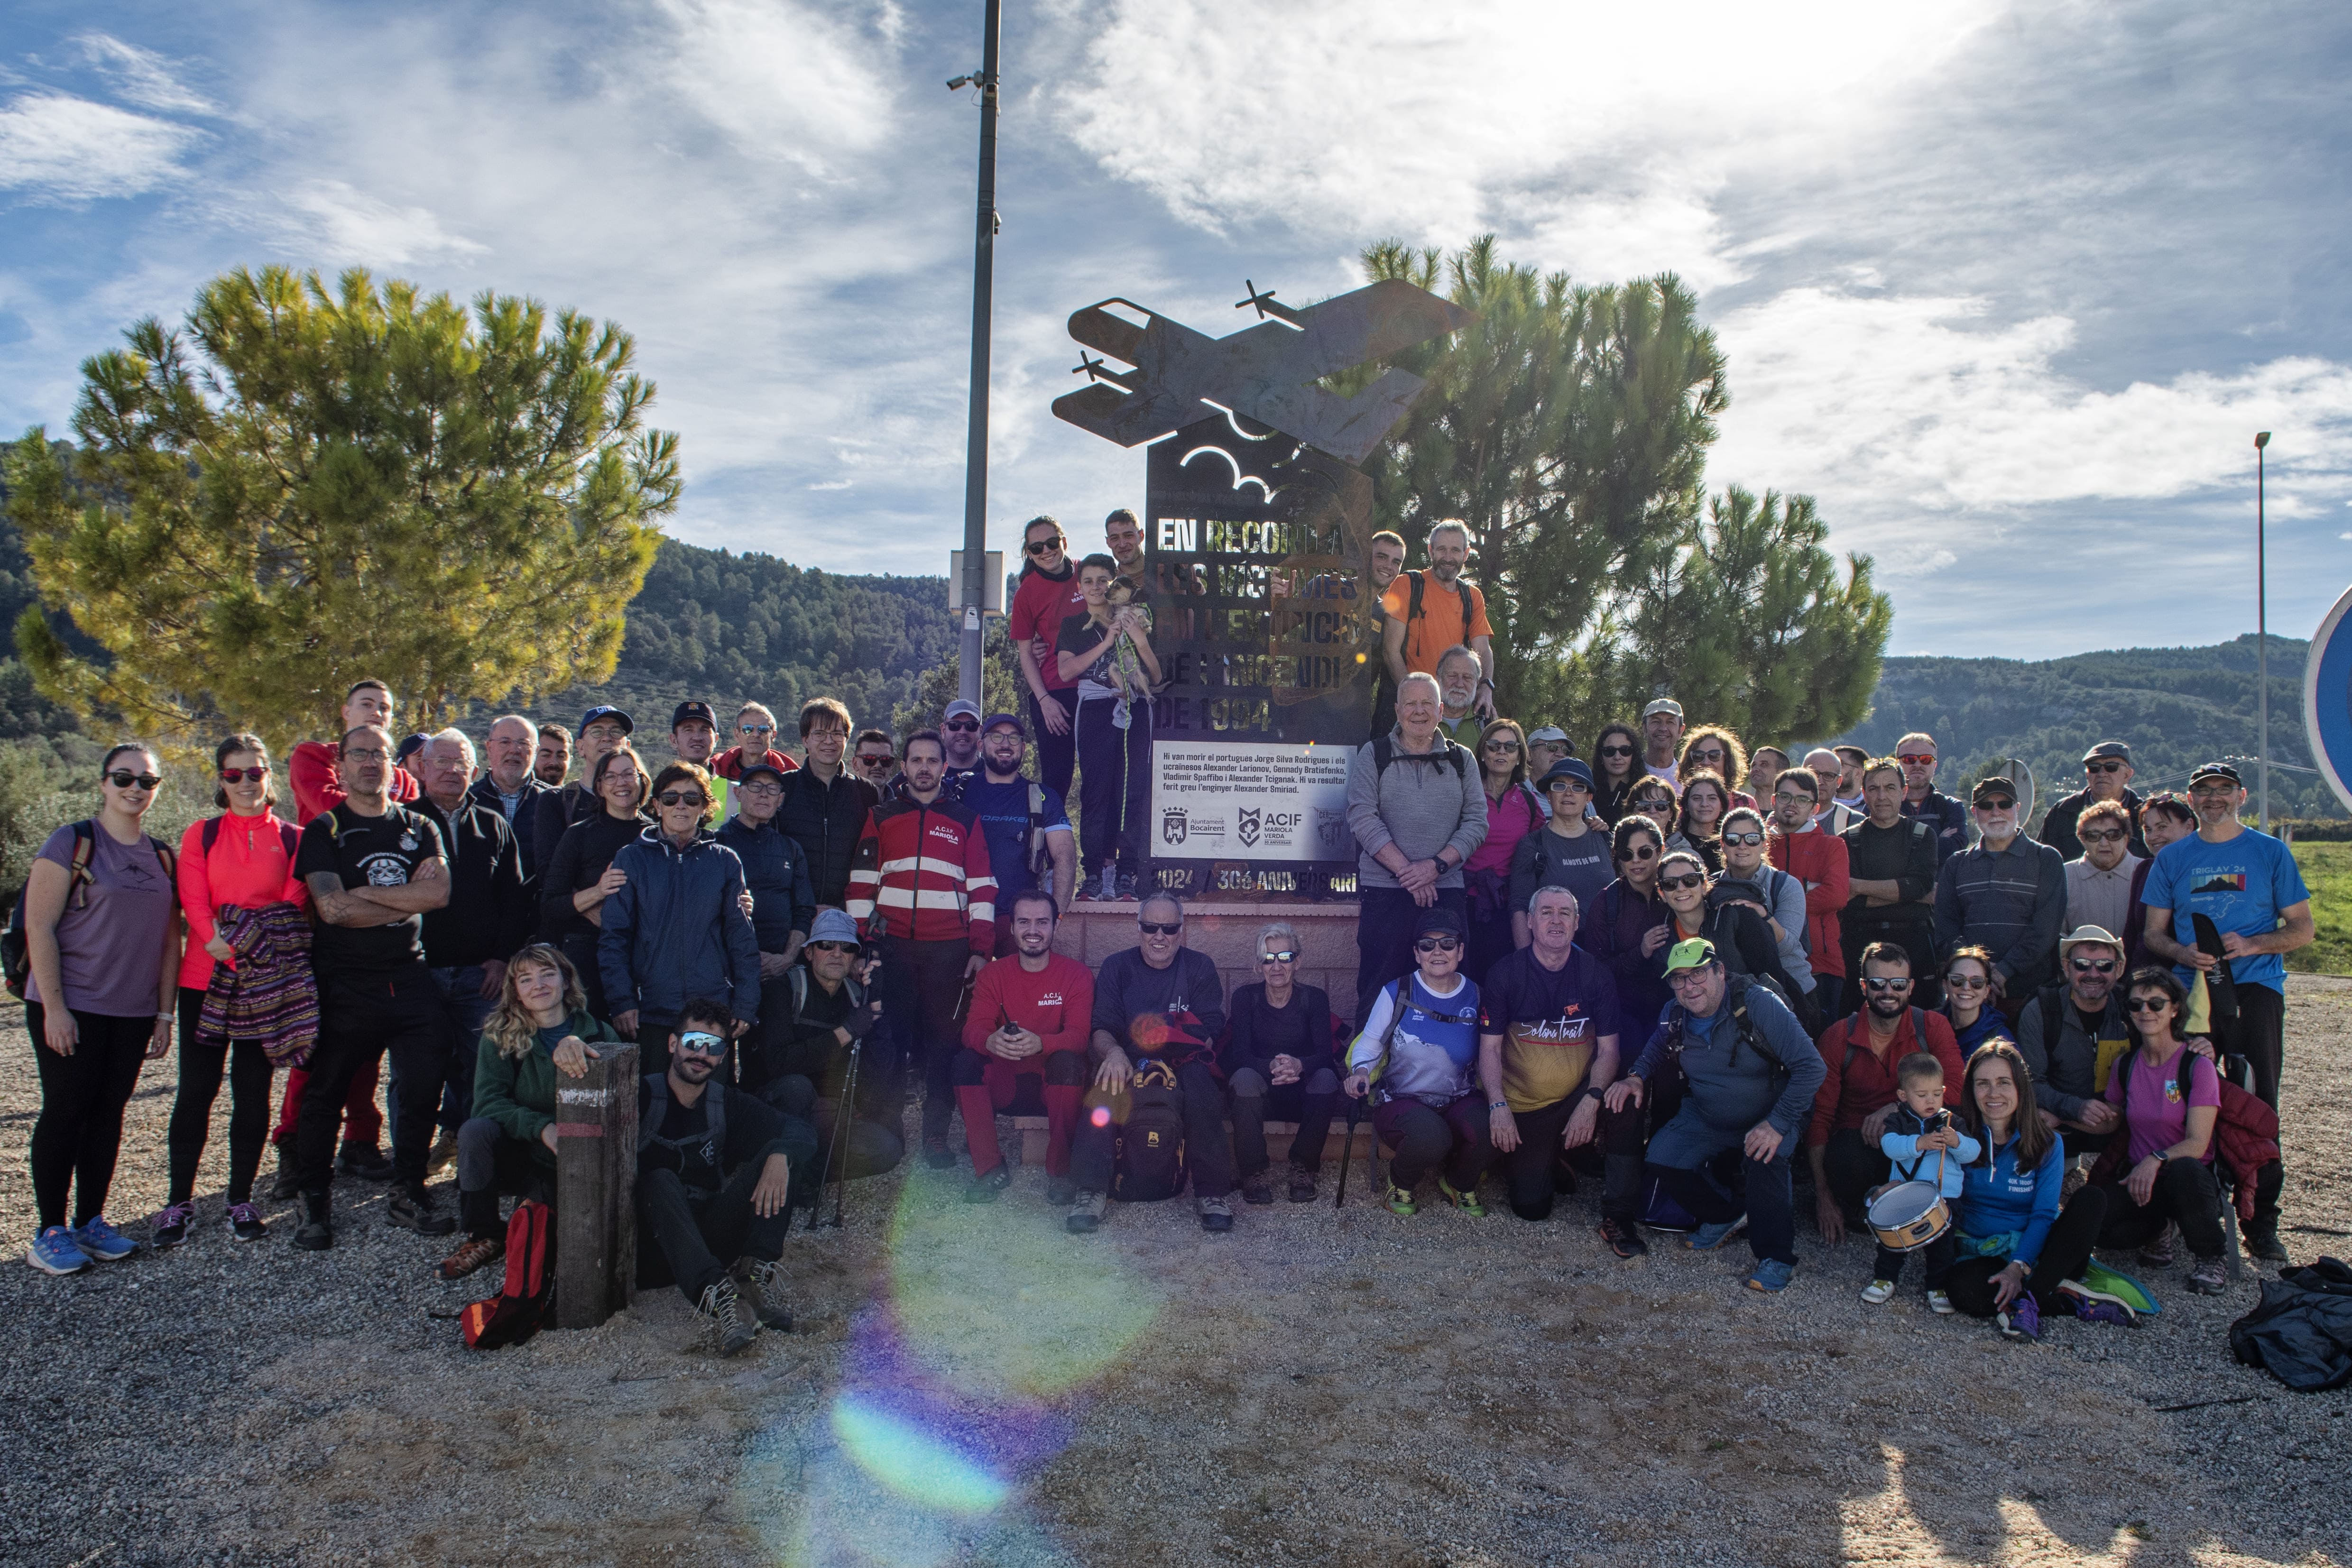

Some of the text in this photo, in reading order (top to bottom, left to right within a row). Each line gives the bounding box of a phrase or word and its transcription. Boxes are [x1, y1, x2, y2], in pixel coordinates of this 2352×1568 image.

[1158, 518, 1197, 552] EN
[1157, 563, 1208, 596] LES
[1155, 697, 1272, 731] DE 1994
[1216, 754, 1253, 763] portugués
[1254, 755, 1274, 764] Jorge
[1276, 755, 1293, 763] Silva
[1295, 756, 1329, 765] Rodrigues
[1203, 764, 1238, 772] Alexander
[1240, 765, 1272, 773] Larionov,
[1273, 766, 1302, 775] Gennady
[1304, 766, 1346, 775] Bratisfenko,
[1163, 773, 1191, 781] Vladimir
[1194, 773, 1223, 782] Spaffibo
[1265, 775, 1298, 784] Tciganak.
[1199, 784, 1232, 793] l'enginyer
[1234, 784, 1268, 793] Alexander
[1270, 785, 1299, 793] Smiriad.
[981, 815, 1029, 823] DRAKE
[1264, 813, 1301, 826] ACIF
[930, 830, 959, 842] MARIOLA
[1562, 858, 1582, 866] ALWAYS
[2192, 866, 2229, 875] TRIGLAV
[1152, 869, 1194, 889] 2024
[1257, 871, 1356, 892] ANIVERSARI
[1518, 1015, 1590, 1041] Solana Trail
